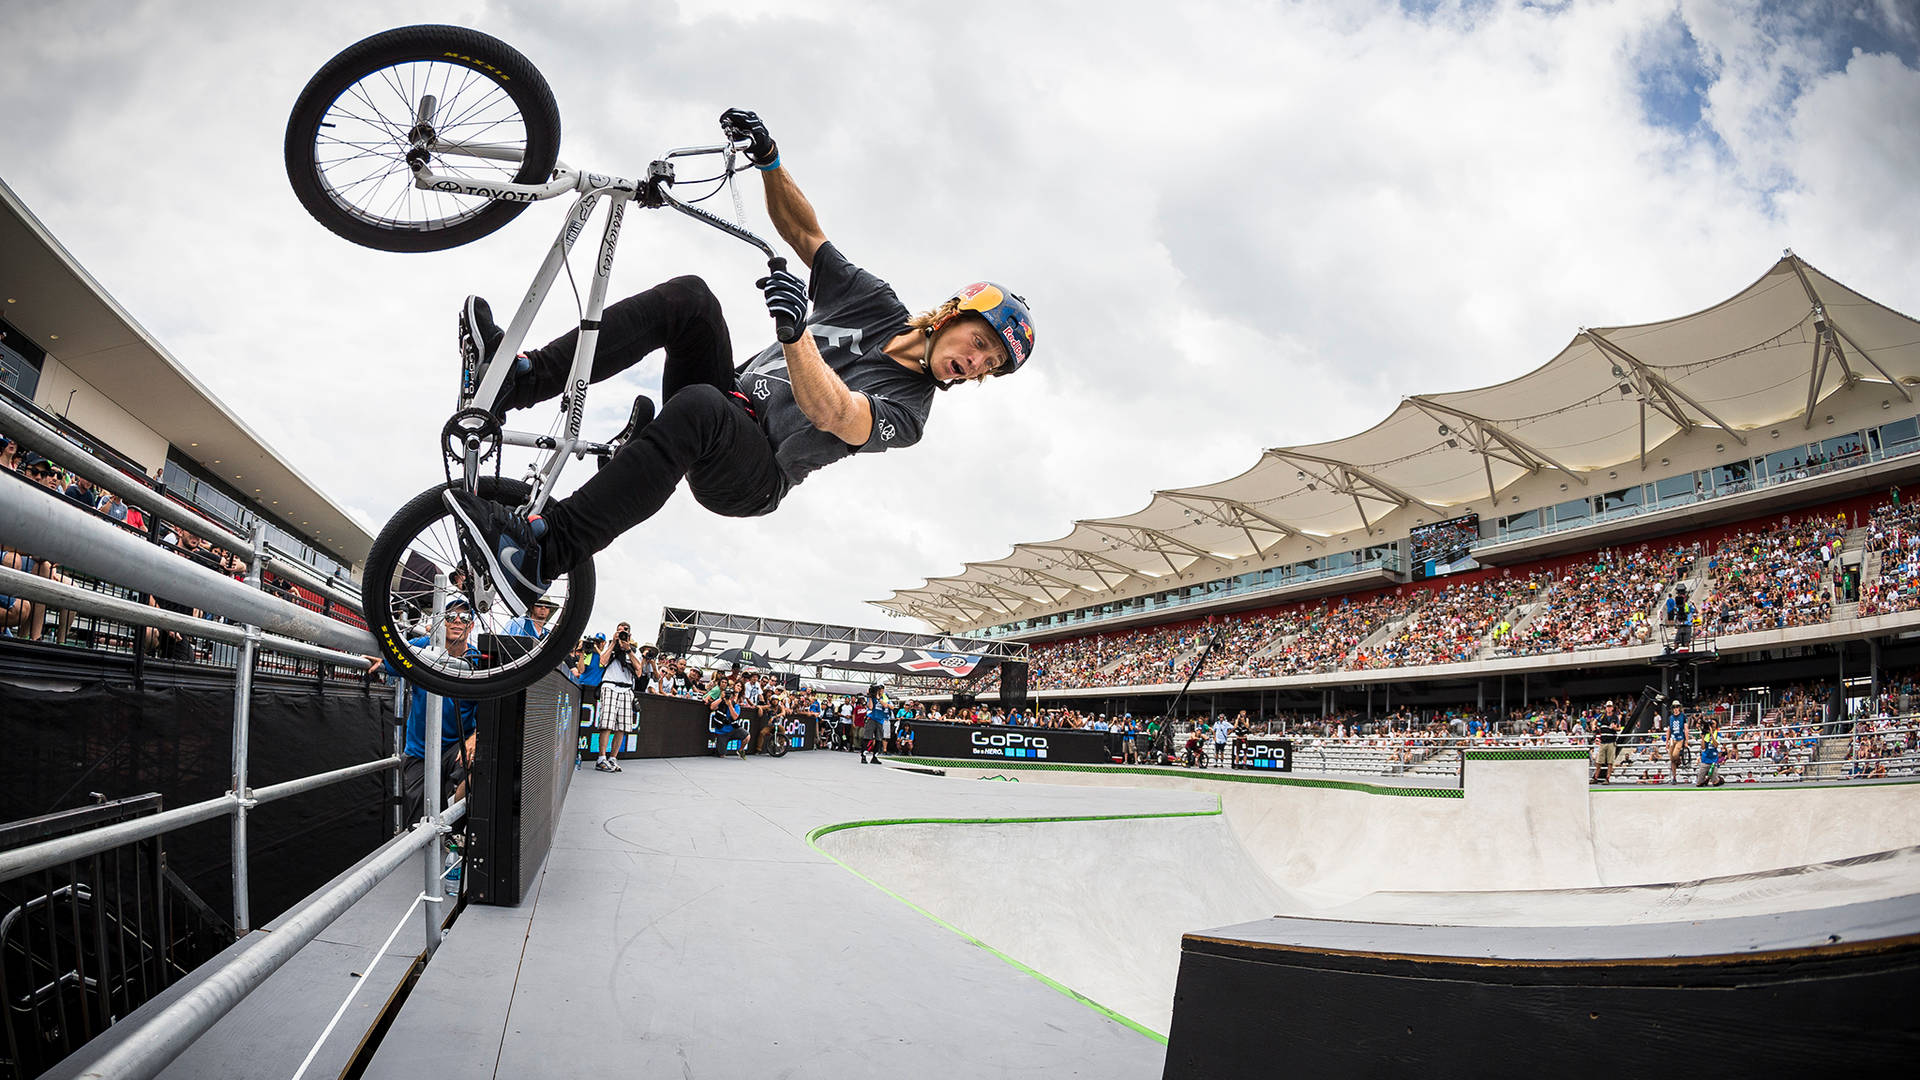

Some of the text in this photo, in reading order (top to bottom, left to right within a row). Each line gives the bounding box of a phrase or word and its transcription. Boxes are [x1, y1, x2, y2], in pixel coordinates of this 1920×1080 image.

[444, 52, 511, 80] MAXXIS
[466, 186, 539, 202] TOYOTA
[381, 625, 413, 669] MAXXIS
[784, 718, 806, 735] GoPro
[971, 731, 1047, 749] GoPro
